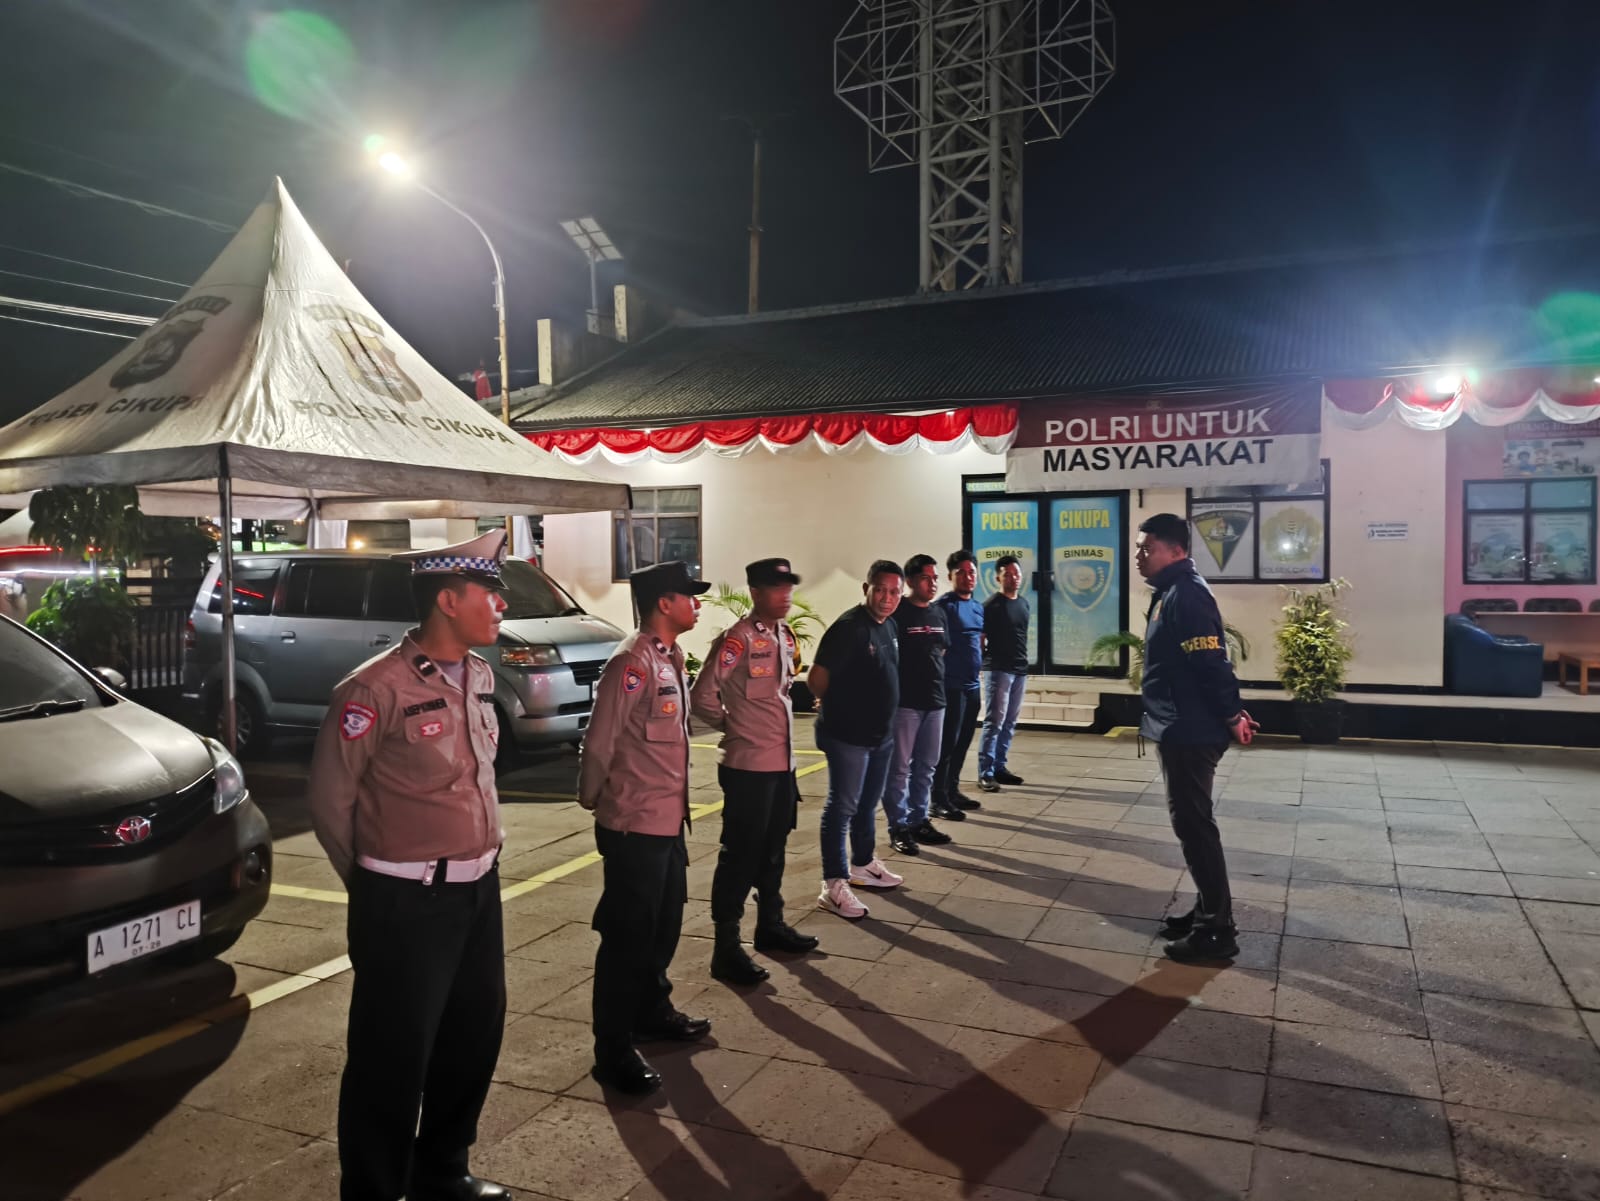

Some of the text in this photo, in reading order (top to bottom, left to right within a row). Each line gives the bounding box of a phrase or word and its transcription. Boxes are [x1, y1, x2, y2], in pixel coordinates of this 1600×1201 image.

[291, 400, 514, 445] POLSEK CIKUPA
[1045, 407, 1271, 443] POLRI UNTUK
[1043, 438, 1273, 472] MASYARAKAT
[981, 509, 1110, 530] POLSEK CIKUPA
[985, 550, 1024, 559] BINMAS
[1063, 549, 1104, 558] BINMAS
[94, 905, 197, 959] A 1271 CL
